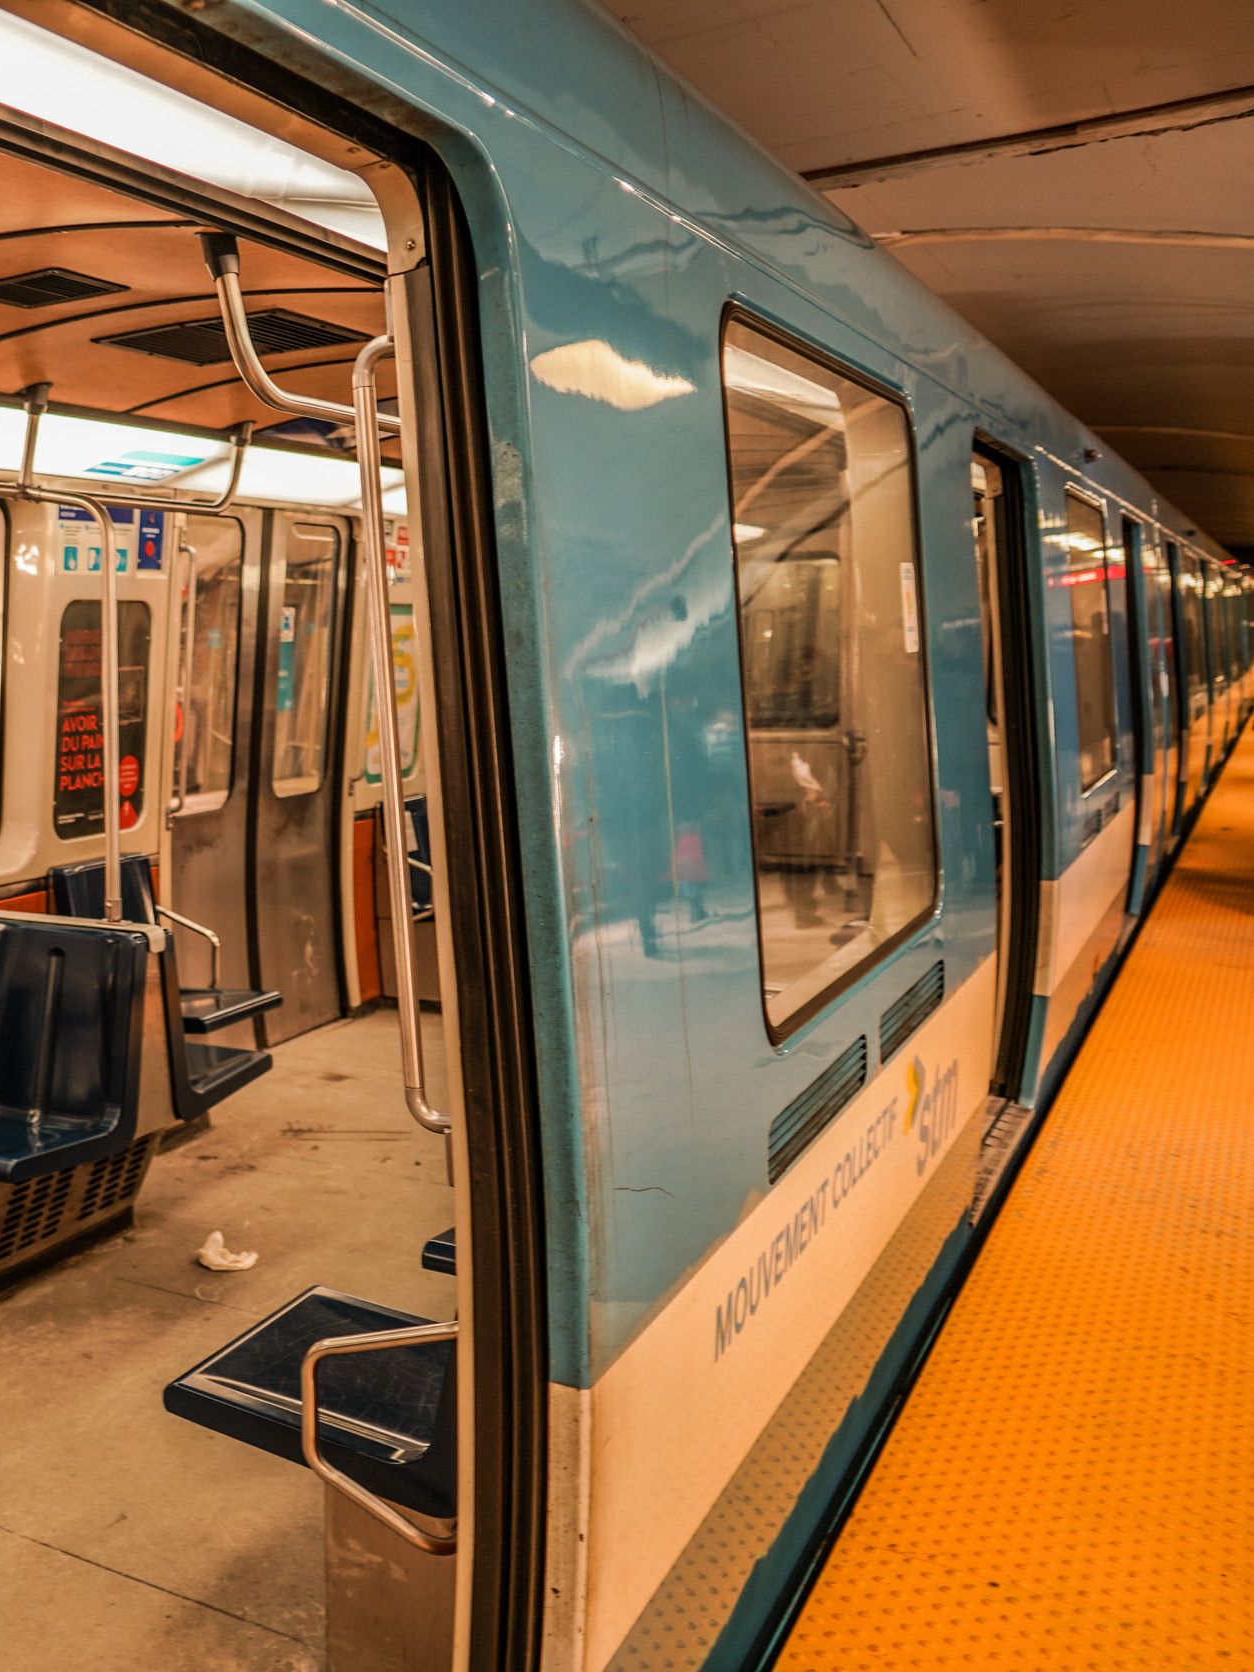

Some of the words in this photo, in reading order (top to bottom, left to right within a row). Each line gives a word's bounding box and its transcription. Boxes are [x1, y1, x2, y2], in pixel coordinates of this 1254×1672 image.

[62, 714, 98, 733] AVOIR
[61, 736, 79, 752] DU
[59, 754, 85, 772] SUR
[87, 754, 101, 769] LA
[915, 1057, 959, 1178] stm
[713, 1177, 830, 1363] MOUVEMENT
[830, 1095, 898, 1211] COLLECTIF
